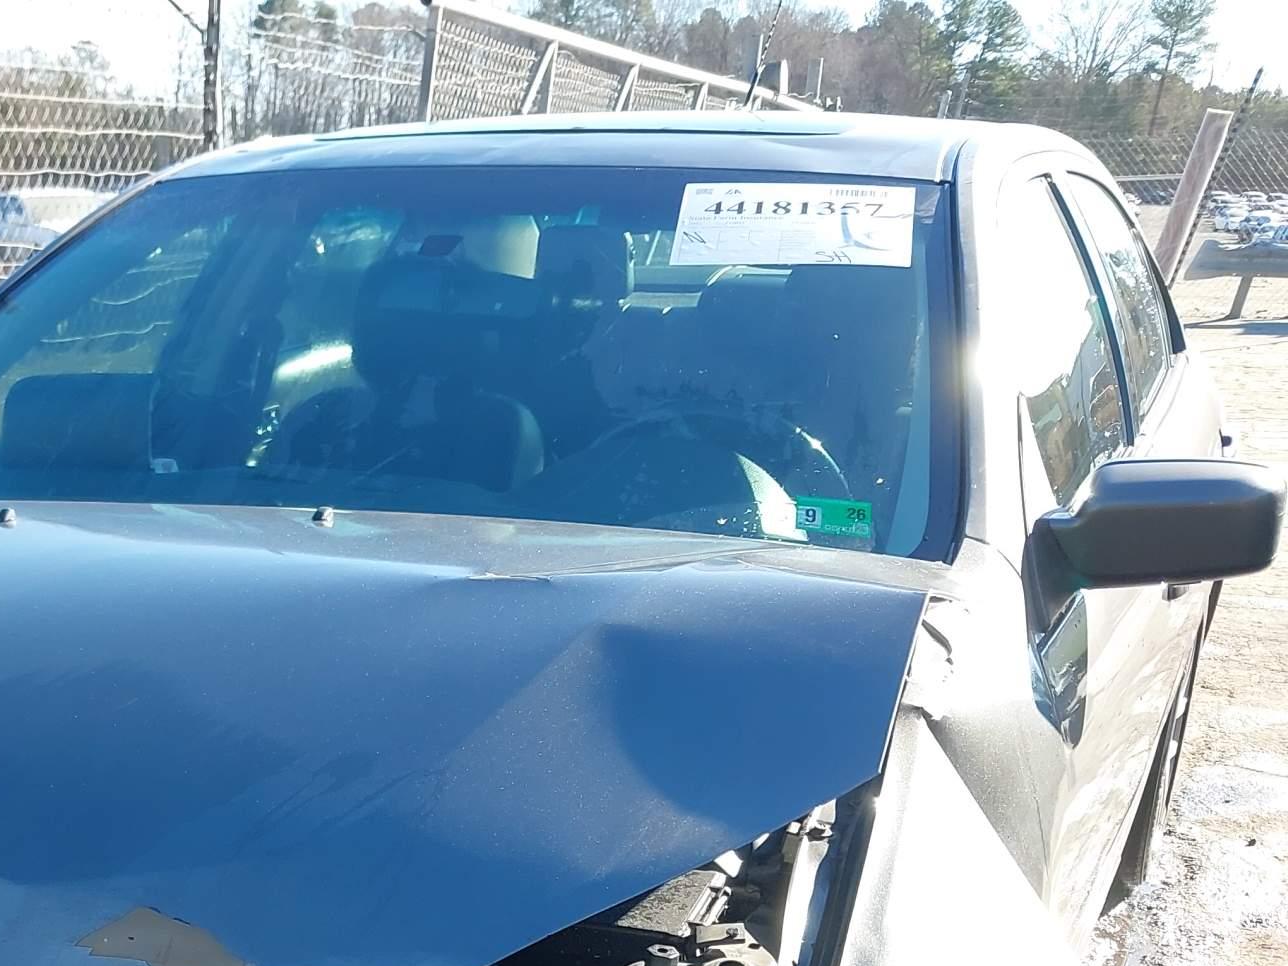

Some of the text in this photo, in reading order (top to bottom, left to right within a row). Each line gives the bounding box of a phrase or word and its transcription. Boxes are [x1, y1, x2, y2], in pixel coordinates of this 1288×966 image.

[704, 200, 884, 217] 44181357
[805, 507, 866, 523] 9 26
